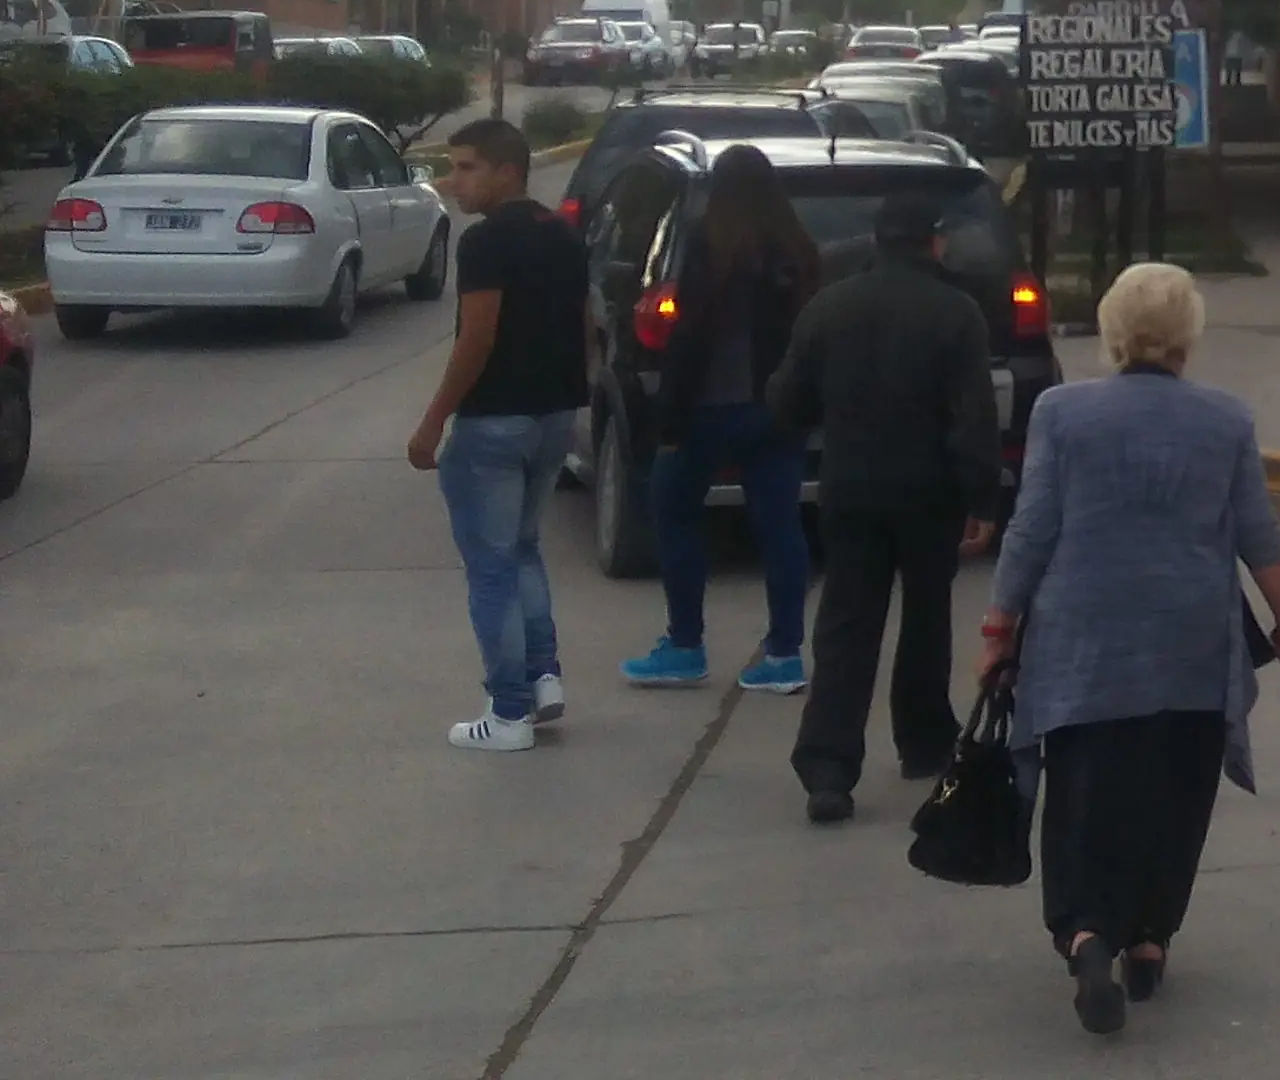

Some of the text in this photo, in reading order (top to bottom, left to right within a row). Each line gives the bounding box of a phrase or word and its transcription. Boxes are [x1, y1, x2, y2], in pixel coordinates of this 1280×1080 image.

[1026, 14, 1171, 44] REGIONALES
[1027, 83, 1173, 112] TORTA GALESA
[1026, 120, 1050, 148] TE
[1053, 120, 1122, 147] DULCES
